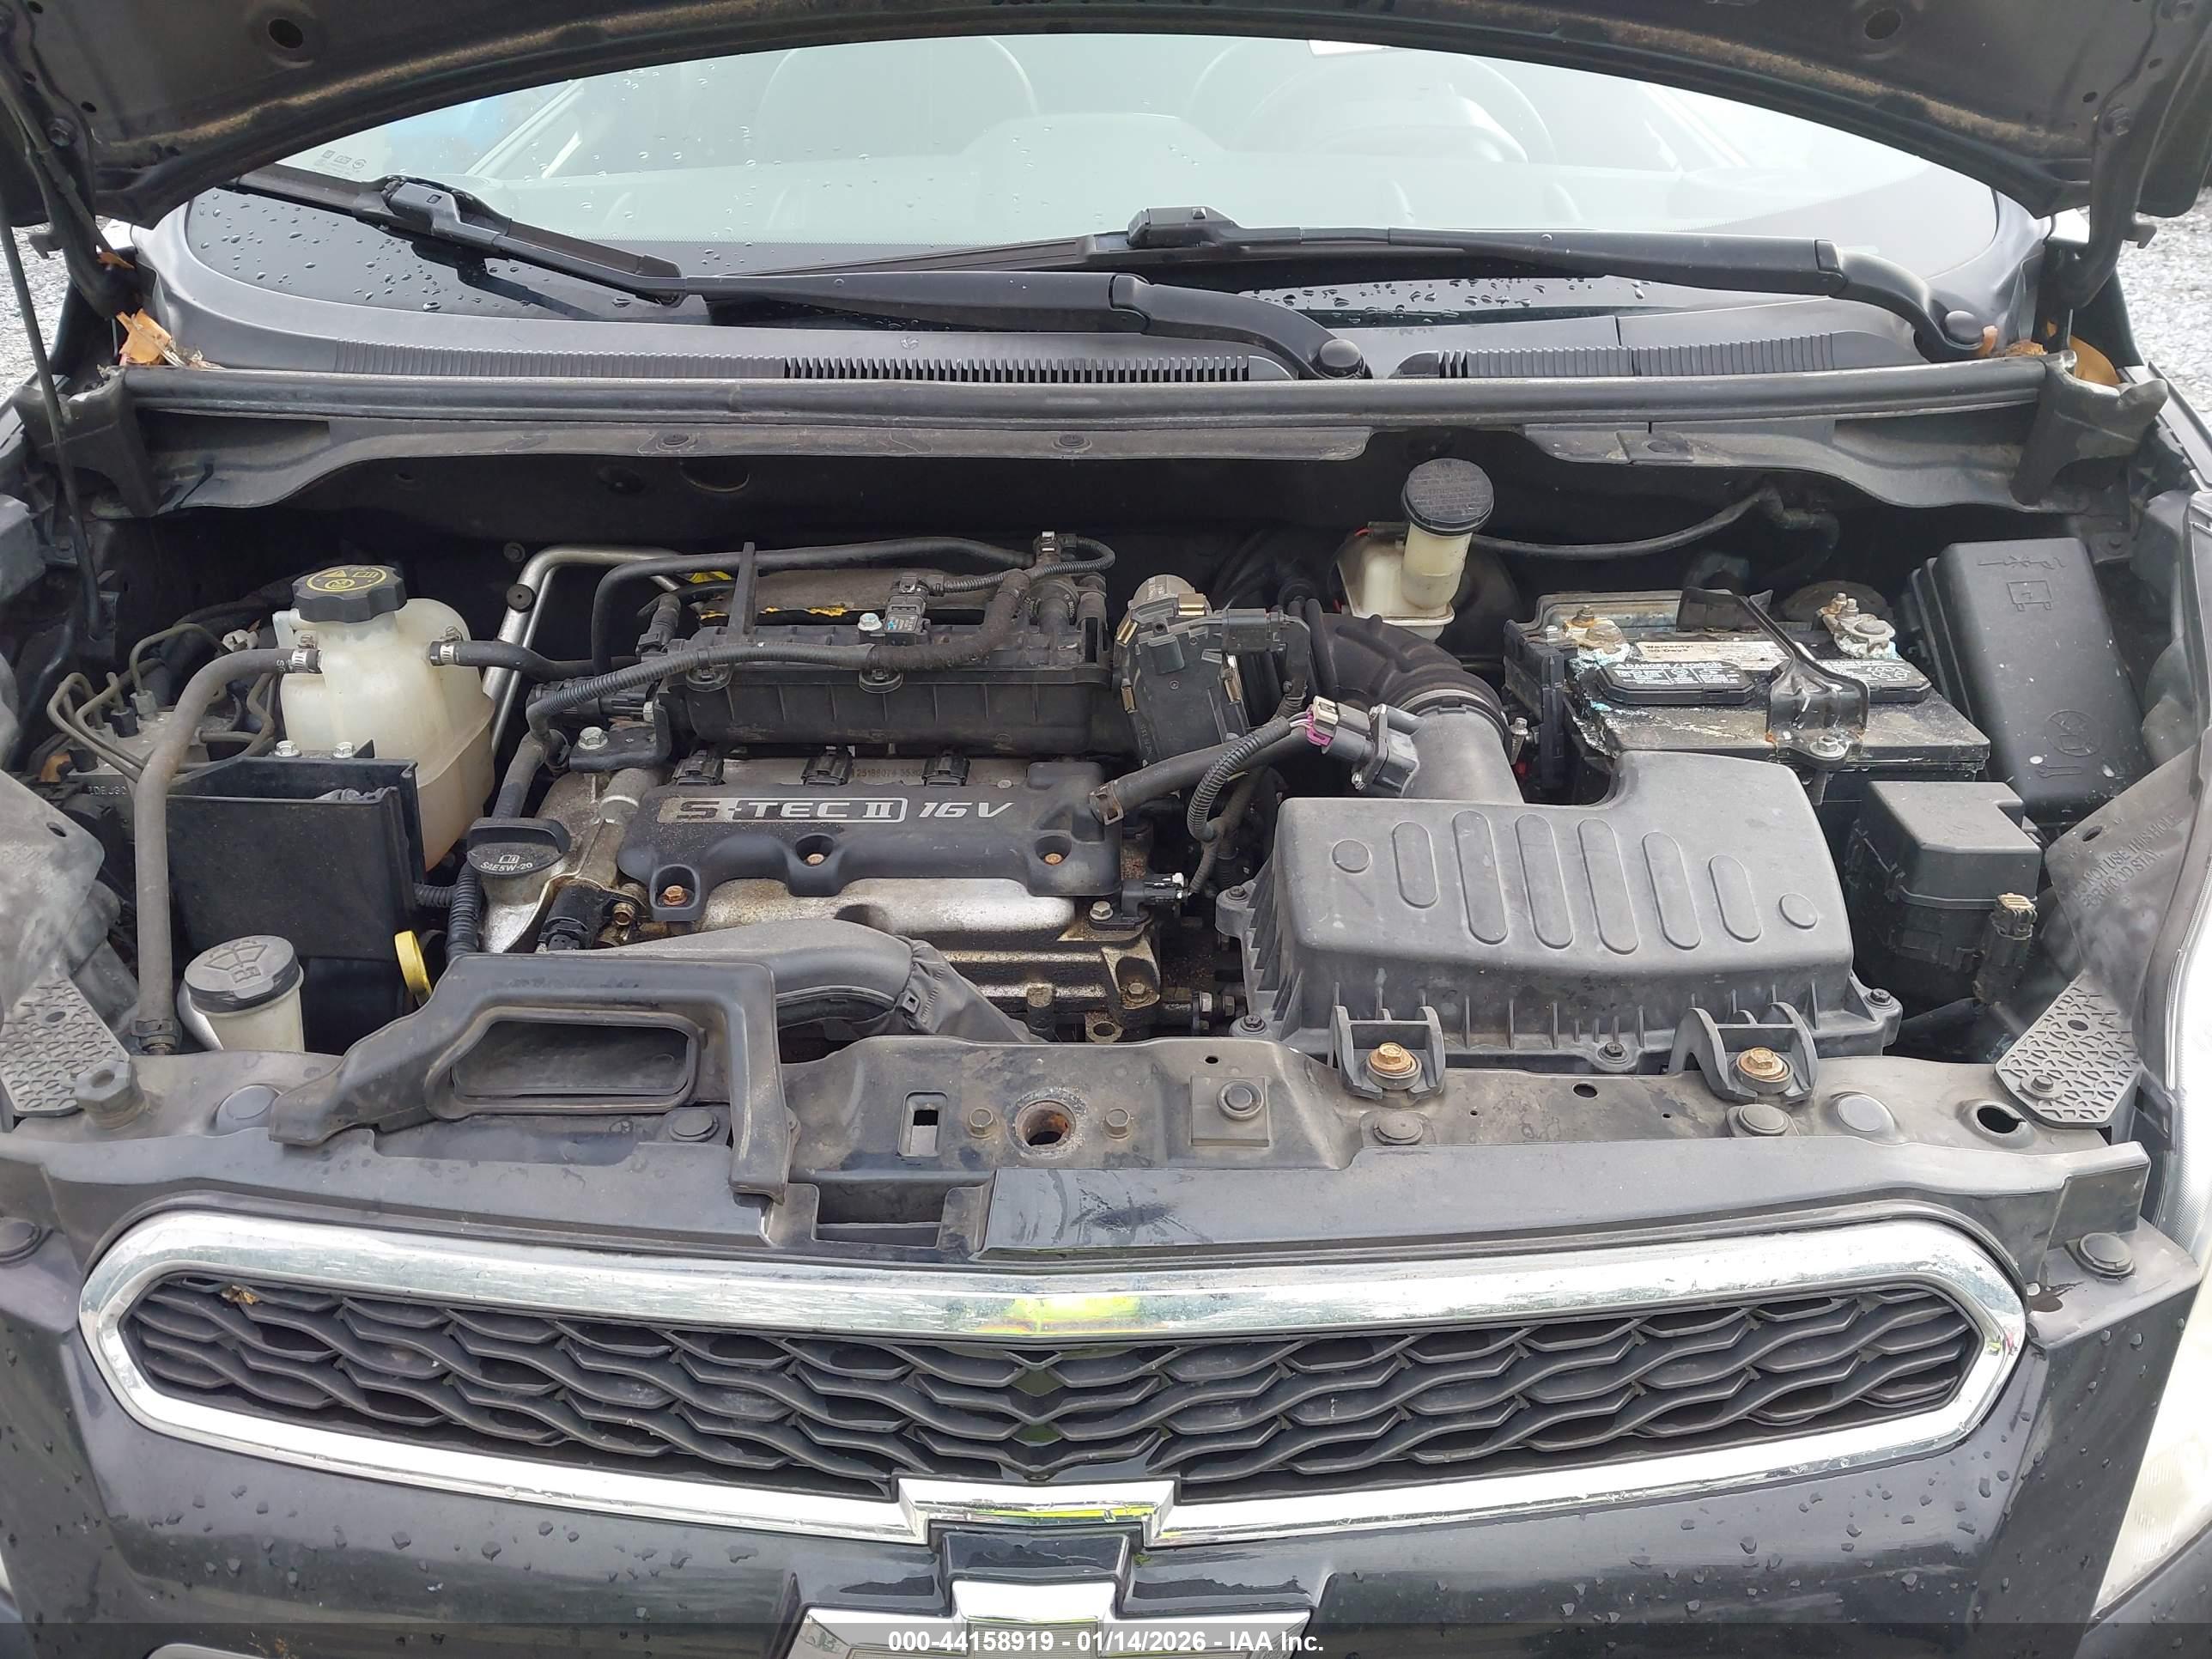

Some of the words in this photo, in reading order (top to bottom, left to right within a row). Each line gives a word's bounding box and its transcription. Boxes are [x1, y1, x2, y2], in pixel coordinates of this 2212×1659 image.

[918, 800, 1015, 819] 16V
[2083, 862, 2109, 886] NOT
[2103, 847, 2131, 870] USE
[2129, 830, 2154, 854] THIS
[2148, 813, 2184, 838] HOLE
[2100, 866, 2136, 895] HOOD
